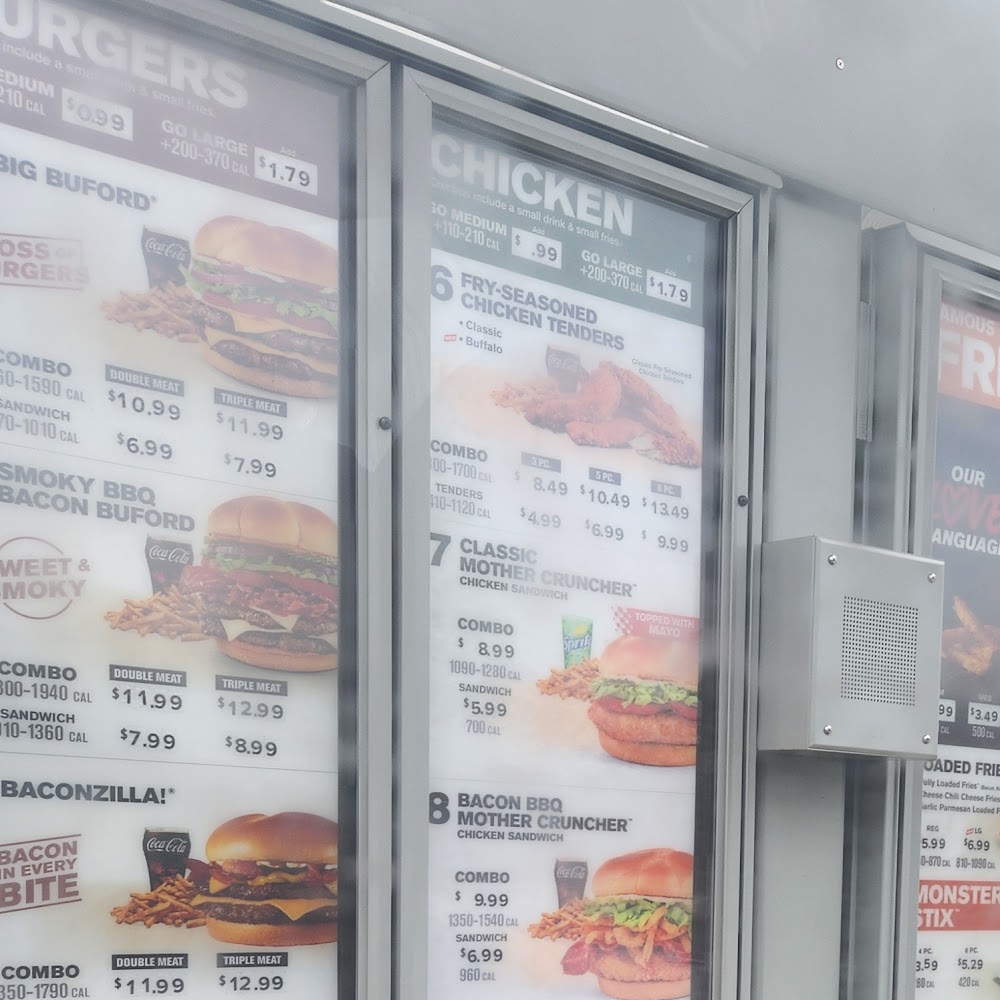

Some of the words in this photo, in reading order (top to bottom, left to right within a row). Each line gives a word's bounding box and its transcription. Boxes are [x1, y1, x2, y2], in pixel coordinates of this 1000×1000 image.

[193, 127, 249, 156] LARGE
[258, 155, 310, 187] $1.79
[432, 133, 633, 236] CHICKEN
[451, 208, 508, 236] MEDIUM
[543, 213, 565, 229] drink
[568, 222, 574, 232] &
[581, 250, 600, 264] GO
[603, 256, 643, 278] LARGE
[461, 271, 598, 325] FRY-SEASONED
[650, 277, 688, 302] $1.79
[461, 292, 542, 328] CHICKEN
[547, 316, 625, 350] TENDERS
[466, 337, 503, 355] Buffalo
[108, 388, 181, 421] $10.99
[117, 432, 173, 460] $6.99
[431, 440, 488, 462] COMBO
[224, 453, 277, 478] $7.99
[0, 462, 95, 494] SMOKY
[103, 480, 156, 507] BBQ
[951, 465, 986, 487] OUR
[436, 483, 483, 500] TENDERS
[580, 485, 630, 508] $10.49
[0, 484, 88, 516] BACON
[97, 501, 195, 533] BUFORD
[585, 520, 624, 541] $6.99
[430, 532, 451, 566] 7
[460, 538, 538, 565] CLASSIC
[460, 557, 536, 582] MOTHER
[460, 576, 508, 592] CHICKEN
[457, 617, 514, 636] COMBO
[0, 660, 77, 681] COMBO
[114, 668, 152, 681] DOUBLE
[156, 673, 182, 684] MEAT
[222, 679, 253, 691] TRIPLE
[256, 681, 281, 693] MEAT
[459, 683, 511, 697] SANDWICH
[112, 687, 182, 710] $11.99
[217, 696, 284, 719] $12.99
[463, 698, 507, 717] $5.99
[0, 709, 75, 723] SANDWICH
[970, 707, 998, 722] $3.49
[120, 728, 176, 749] $7.99
[225, 736, 278, 756] $8.99
[936, 780, 960, 789] Loaded
[457, 793, 521, 811] BACON
[526, 796, 563, 813] BBQ
[972, 805, 995, 815] Loaded
[457, 811, 532, 828] MOTHER
[457, 830, 505, 840] CHICKEN
[508, 831, 564, 842] SANDWICH
[964, 838, 990, 851] $6.99
[0, 841, 77, 865] BACON
[21, 858, 76, 877] EVERY
[455, 871, 510, 884] COMBO
[0, 873, 79, 906] BITE
[455, 933, 507, 943] SANDWICH
[117, 957, 154, 967] DOUBLE
[157, 956, 183, 966] MEAT
[224, 955, 254, 965] TRIPLE
[257, 954, 281, 965] MEAT
[460, 948, 503, 963] $6.99
[958, 959, 983, 970] $5.29
[1, 965, 80, 980] COMBO
[459, 968, 481, 982] 960
[114, 977, 184, 995] $11.99
[219, 974, 284, 992] $12.99
